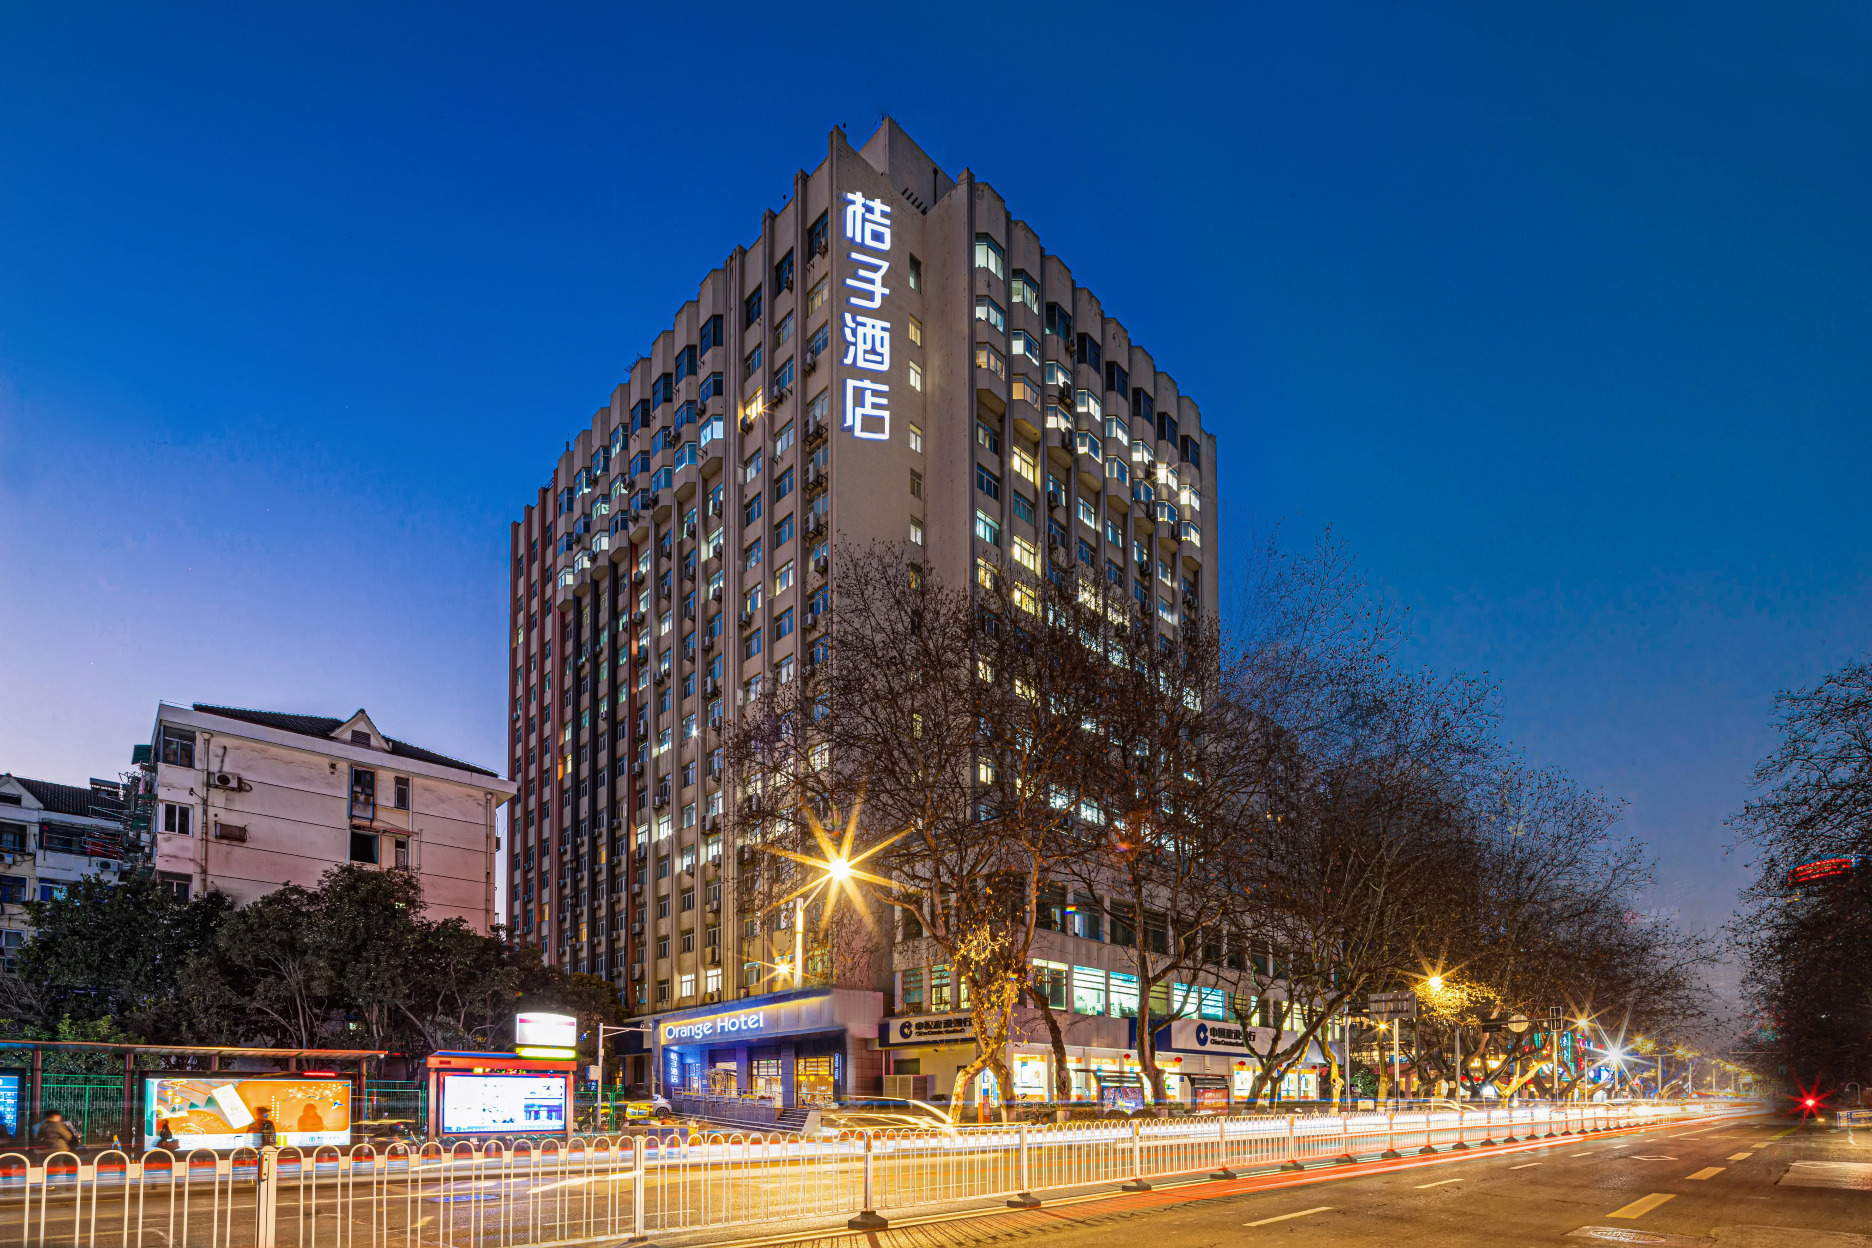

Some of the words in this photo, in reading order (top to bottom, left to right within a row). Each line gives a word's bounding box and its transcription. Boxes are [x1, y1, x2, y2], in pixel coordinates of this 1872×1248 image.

[842, 191, 891, 440] 桔子酒店
[665, 1022, 713, 1039] Orange
[717, 1011, 764, 1033] Hotel
[1210, 1027, 1256, 1041] 中国建设行
